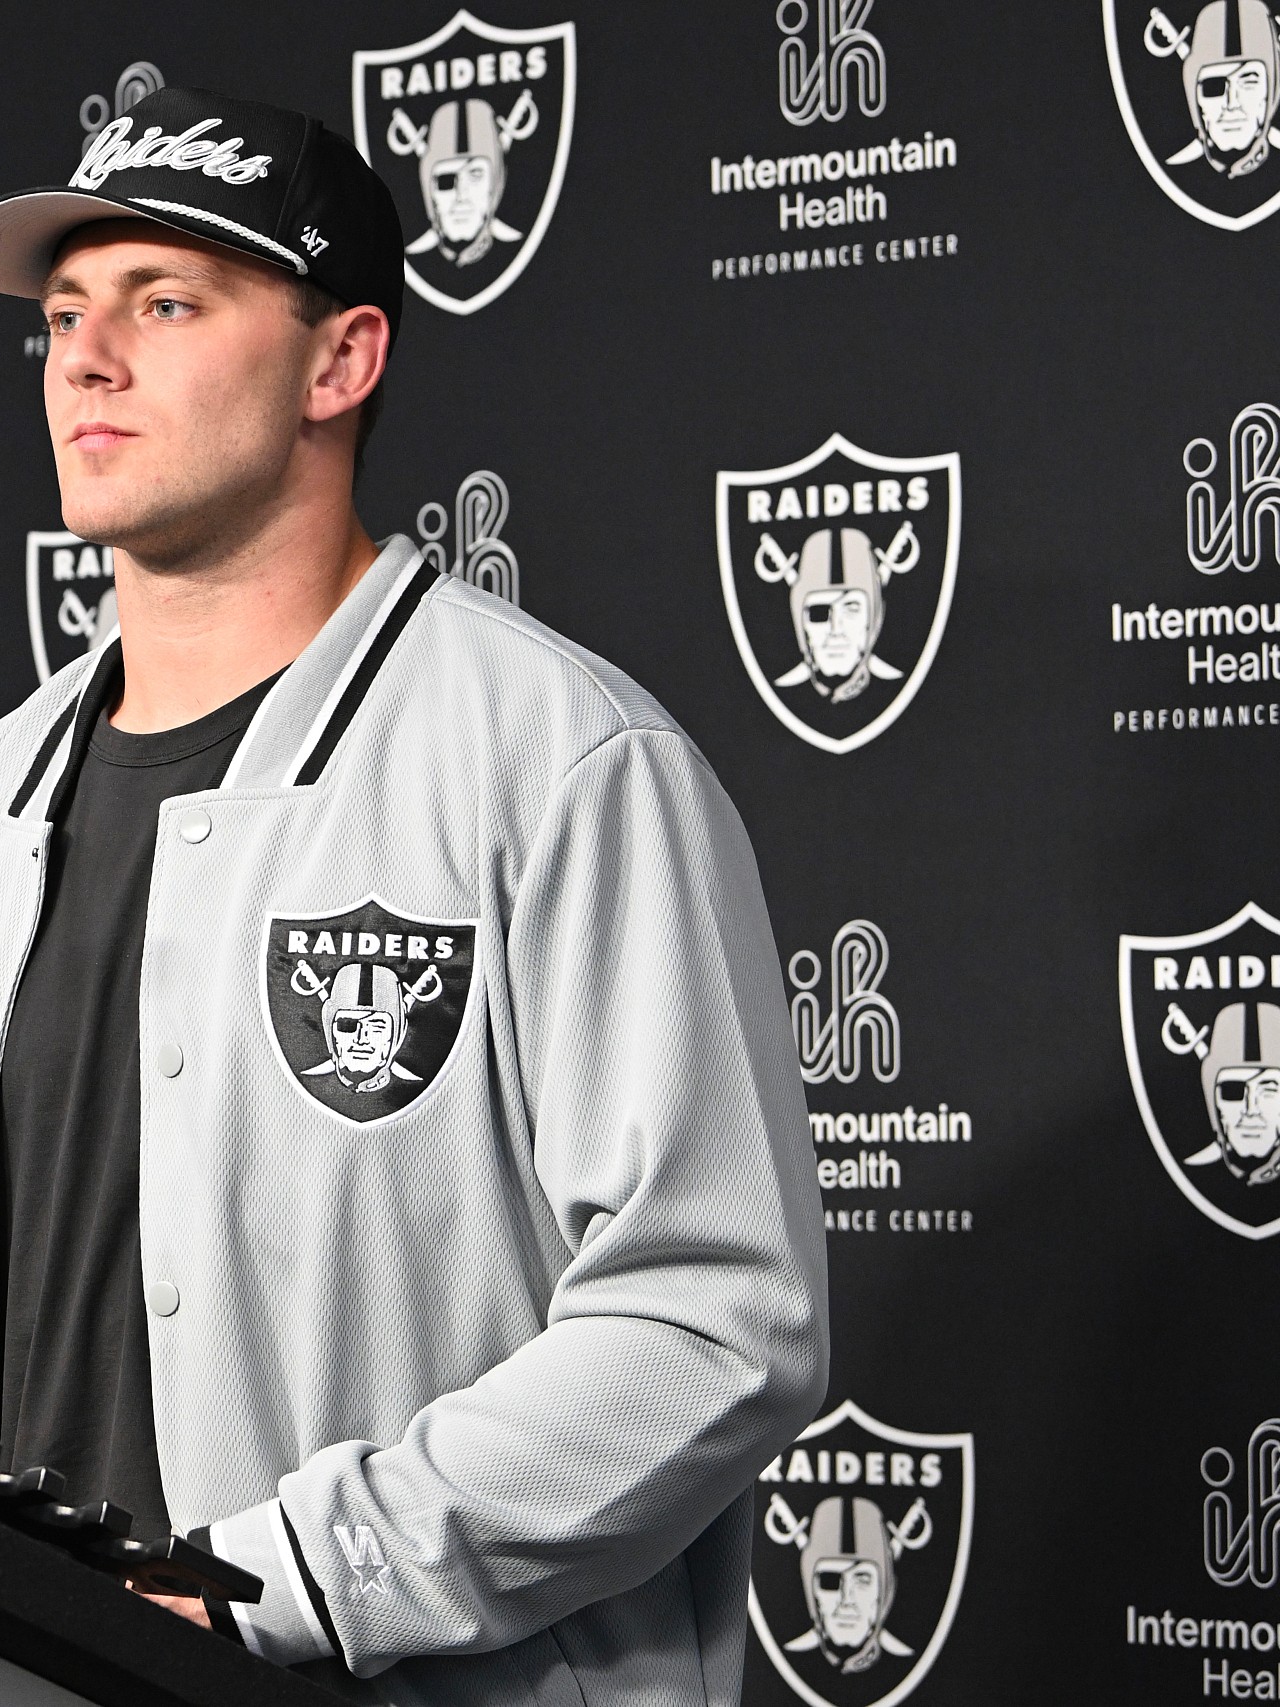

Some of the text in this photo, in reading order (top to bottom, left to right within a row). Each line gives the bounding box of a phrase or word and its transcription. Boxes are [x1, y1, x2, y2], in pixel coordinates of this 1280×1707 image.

[381, 46, 547, 99] RAIDERS
[68, 116, 272, 190] Raiders
[711, 131, 956, 194] Intermountain
[779, 184, 887, 231] Health
[712, 234, 959, 280] PERFORMANCE CENTER
[748, 477, 929, 523] RAIDERS
[1112, 603, 1280, 642] Intermou
[1188, 642, 1280, 685] Healt
[1114, 703, 1280, 733] PERFORMANCE
[287, 930, 454, 960] RAIDERS
[1154, 954, 1280, 990] RAID
[809, 1103, 972, 1143] mountain
[816, 1150, 901, 1189] ealth
[889, 1209, 973, 1232] CENTER
[1127, 1605, 1280, 1651] Intermo
[1203, 1658, 1280, 1700] Hea
